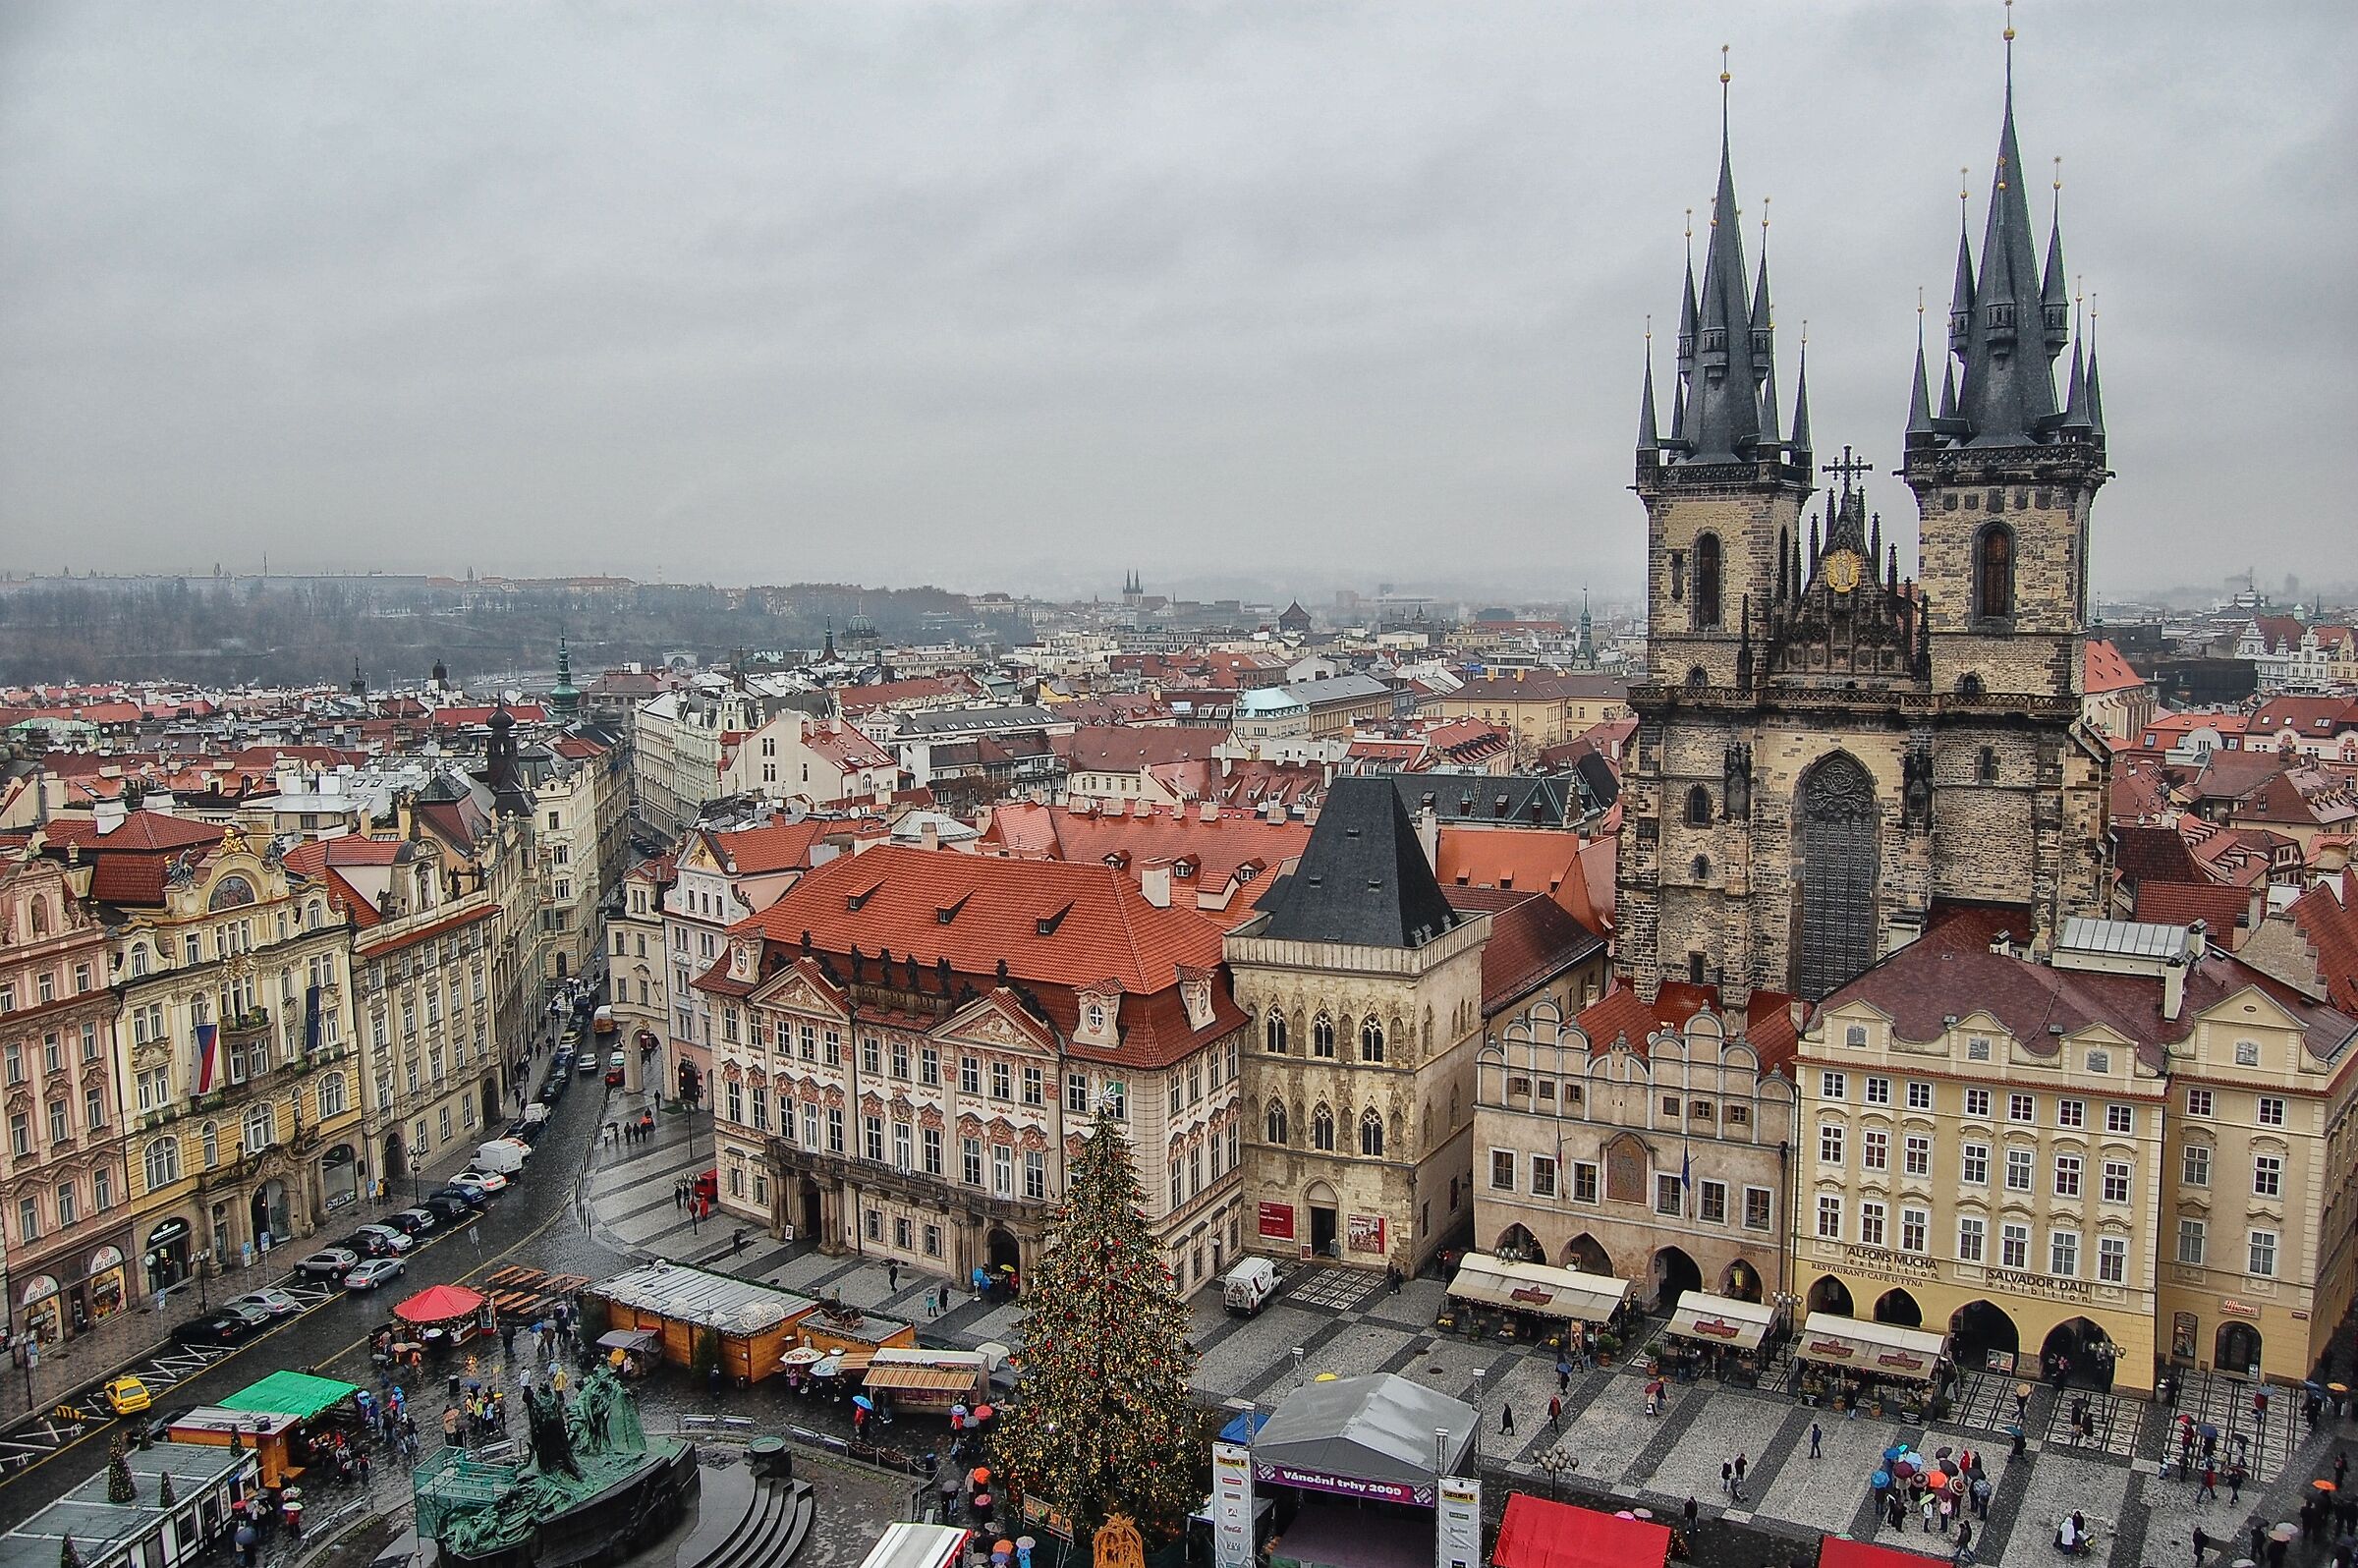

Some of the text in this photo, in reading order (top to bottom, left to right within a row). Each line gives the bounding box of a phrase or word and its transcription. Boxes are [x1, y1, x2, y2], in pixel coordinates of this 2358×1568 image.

[1847, 1247, 1937, 1269] ALFONS MUCHA
[1849, 1259, 1937, 1279] exhibition
[1811, 1262, 1867, 1278] RESTAURANT
[1891, 1275, 1898, 1284] U
[1988, 1268, 2054, 1289] SALVADOR
[1987, 1280, 2089, 1304] exhibition
[1282, 1471, 1402, 1496] Vánoční trhy 2009
